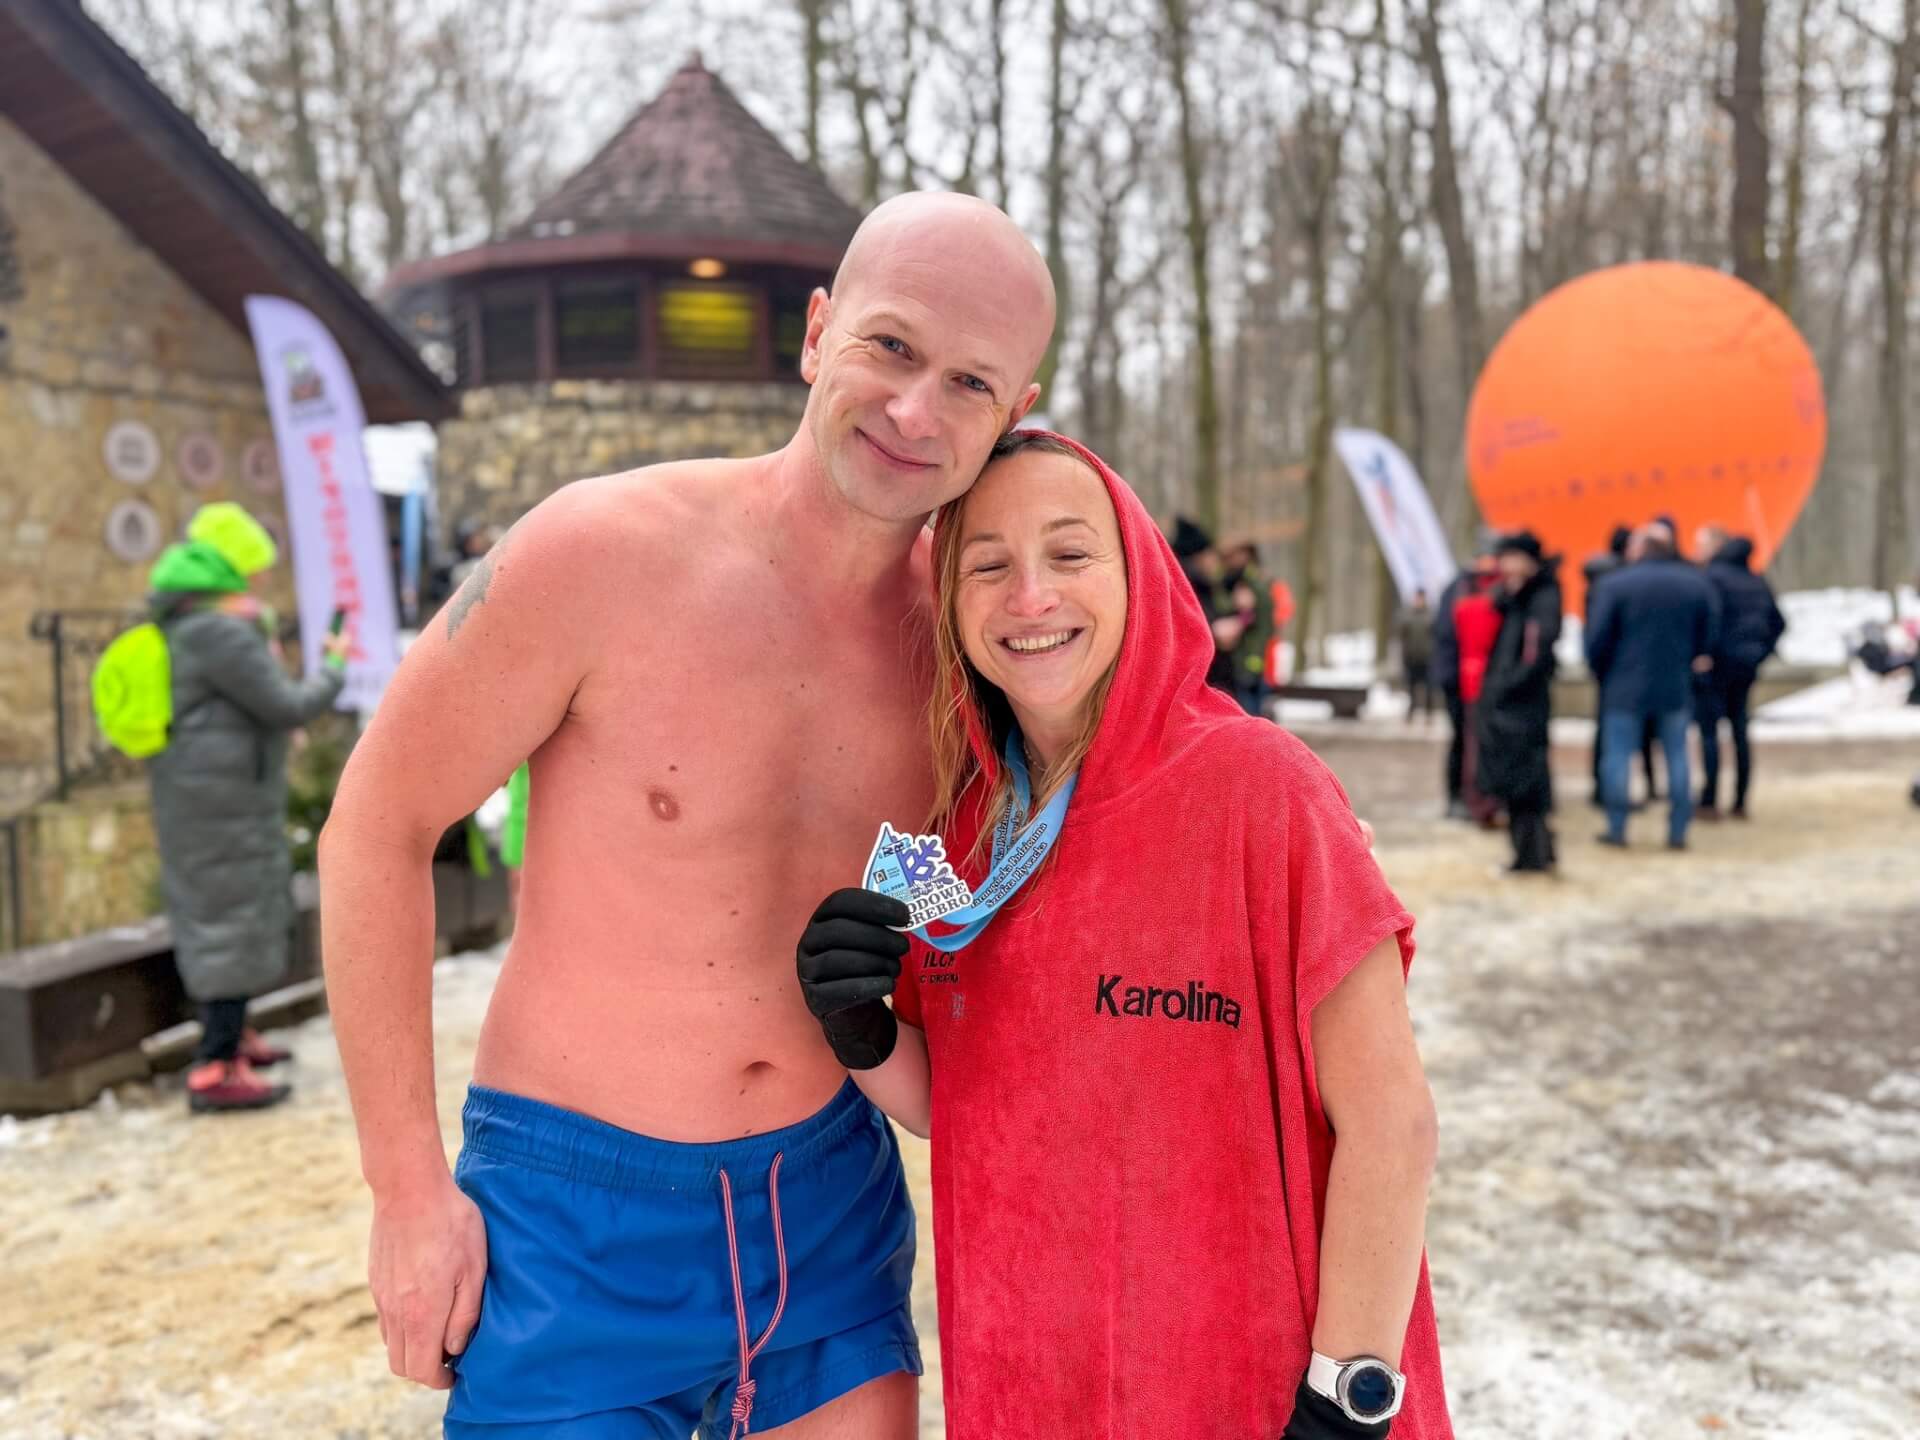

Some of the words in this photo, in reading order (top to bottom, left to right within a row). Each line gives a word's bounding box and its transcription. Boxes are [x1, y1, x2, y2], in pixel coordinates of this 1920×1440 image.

[906, 882, 966, 914] ODOWE
[985, 879, 1017, 908] Sztafeta
[1095, 974, 1241, 1029] Karolina
